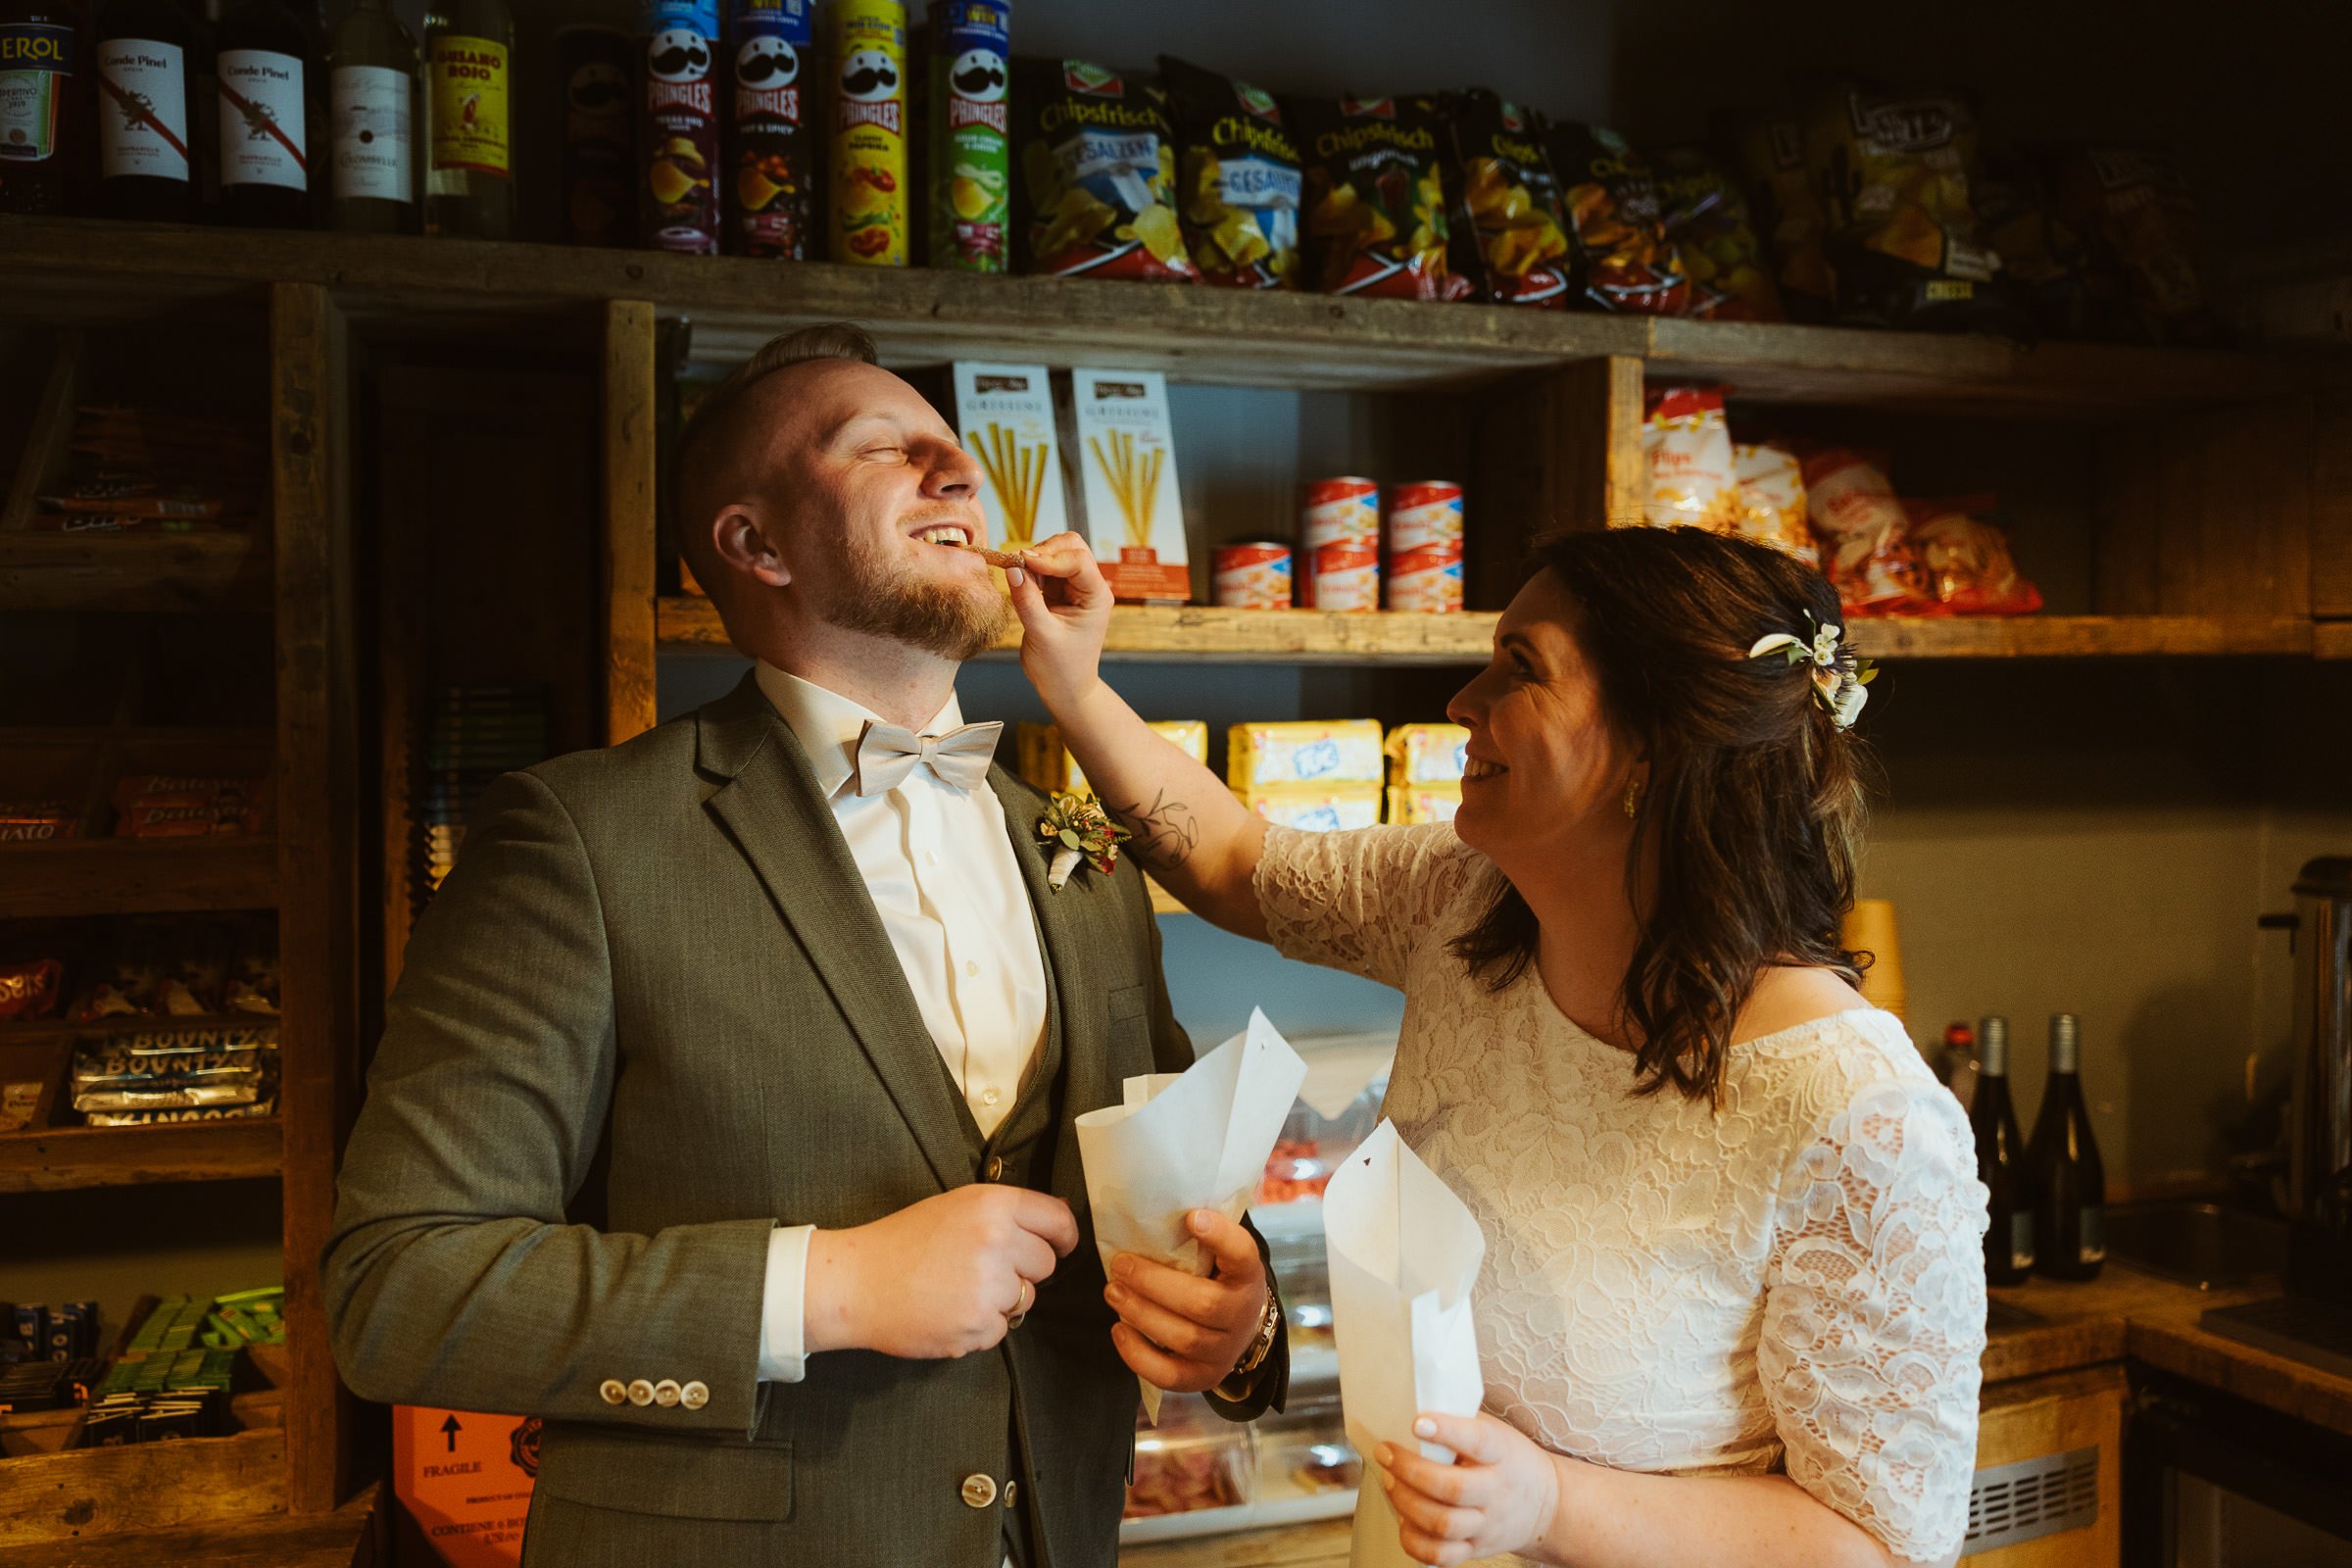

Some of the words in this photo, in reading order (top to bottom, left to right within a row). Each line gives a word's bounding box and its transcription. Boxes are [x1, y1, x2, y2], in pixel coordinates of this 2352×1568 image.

[2, 36, 64, 62] EROL
[105, 55, 136, 67] Conde
[137, 56, 167, 69] Pinel
[227, 65, 259, 76] Conde
[262, 67, 289, 81] Pinel
[648, 80, 712, 115] PRINGLES
[737, 88, 800, 122] PRINGLES
[839, 101, 900, 133] PRINGLES
[951, 96, 1007, 135] PRINGLES
[1040, 94, 1161, 132] Chipsfrisch
[133, 1029, 254, 1051] BOUNTY
[106, 1053, 232, 1077] BOUNTY
[423, 1461, 482, 1478] FRAGILE
